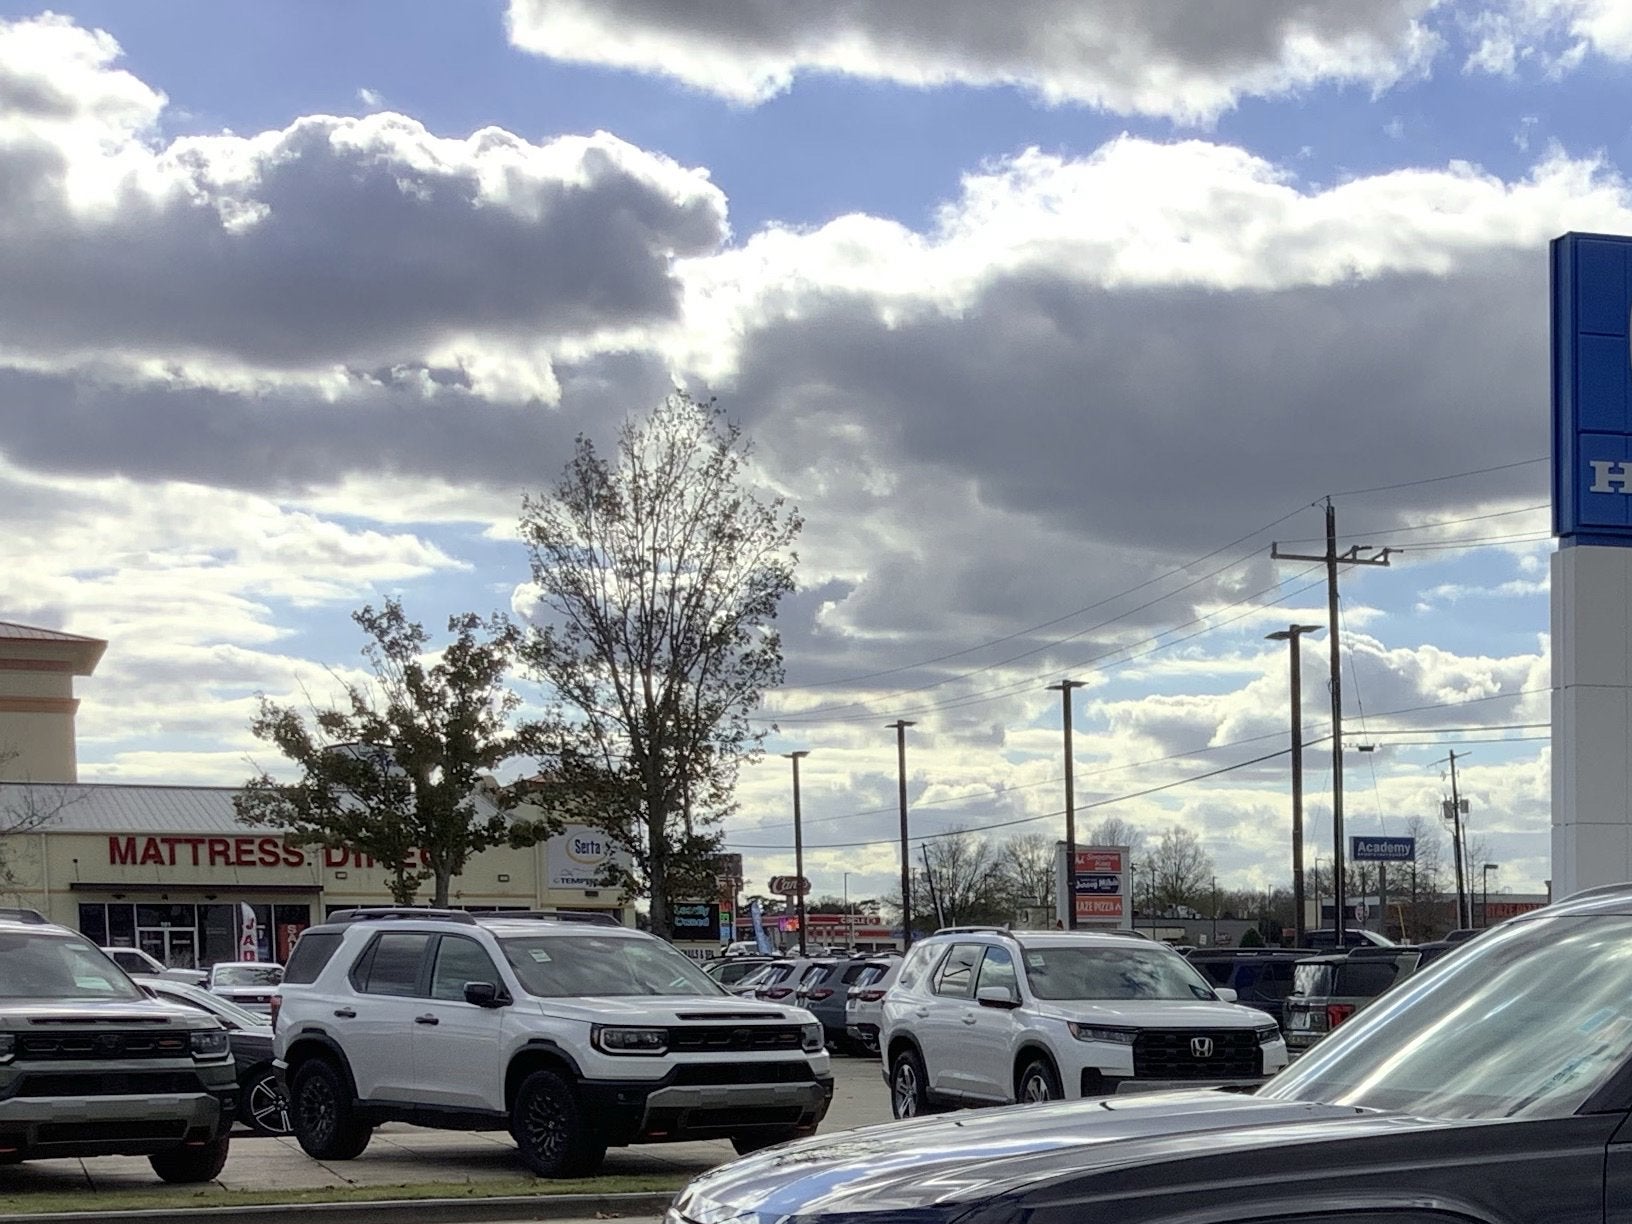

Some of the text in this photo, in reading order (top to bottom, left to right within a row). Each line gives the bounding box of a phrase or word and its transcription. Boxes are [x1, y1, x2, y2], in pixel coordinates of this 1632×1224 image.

[109, 836, 304, 866] MATTRESS
[575, 839, 600, 854] Serta
[1358, 841, 1410, 856] Academy
[772, 877, 808, 892] Cans
[1076, 901, 1114, 911] LAZE PIZZA
